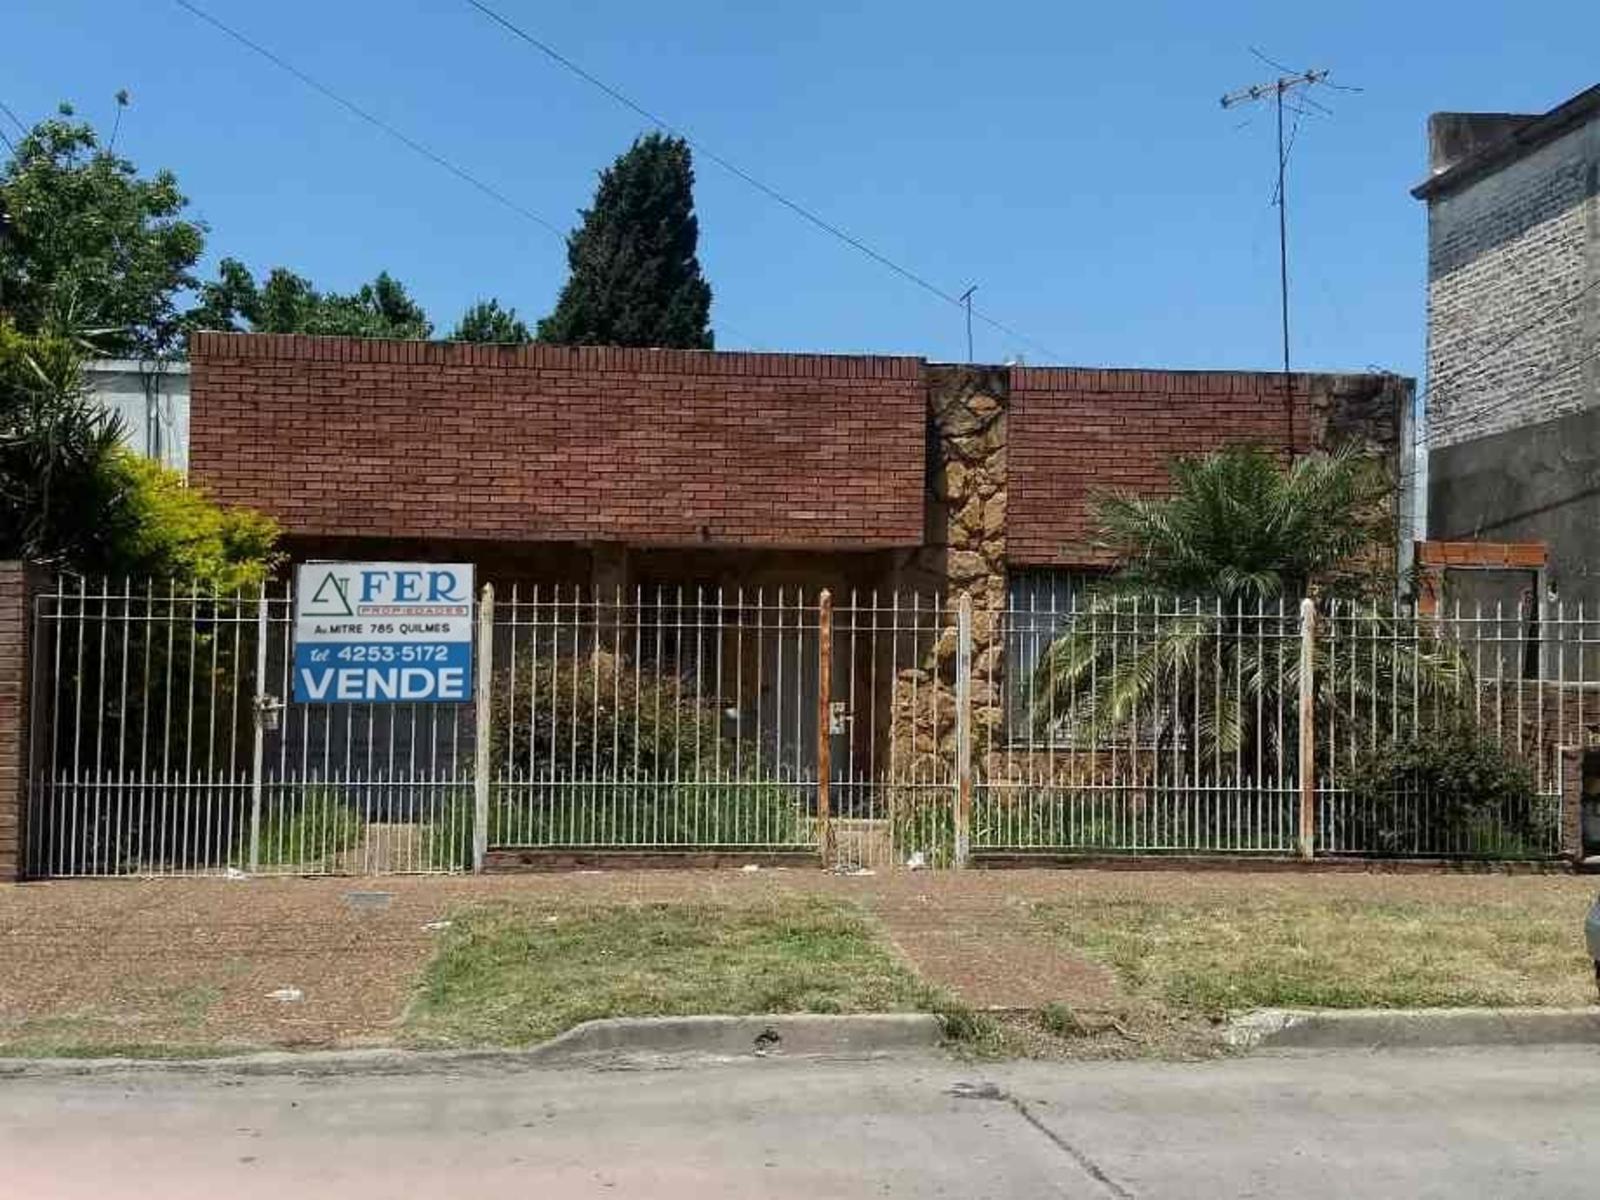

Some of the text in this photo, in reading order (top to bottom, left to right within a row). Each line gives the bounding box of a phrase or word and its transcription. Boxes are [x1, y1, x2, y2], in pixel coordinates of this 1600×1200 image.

[360, 571, 467, 603] FER
[330, 624, 363, 633] MITRE
[370, 624, 394, 633] 785
[399, 623, 450, 634] QUILMES
[301, 667, 463, 699] VENDE
